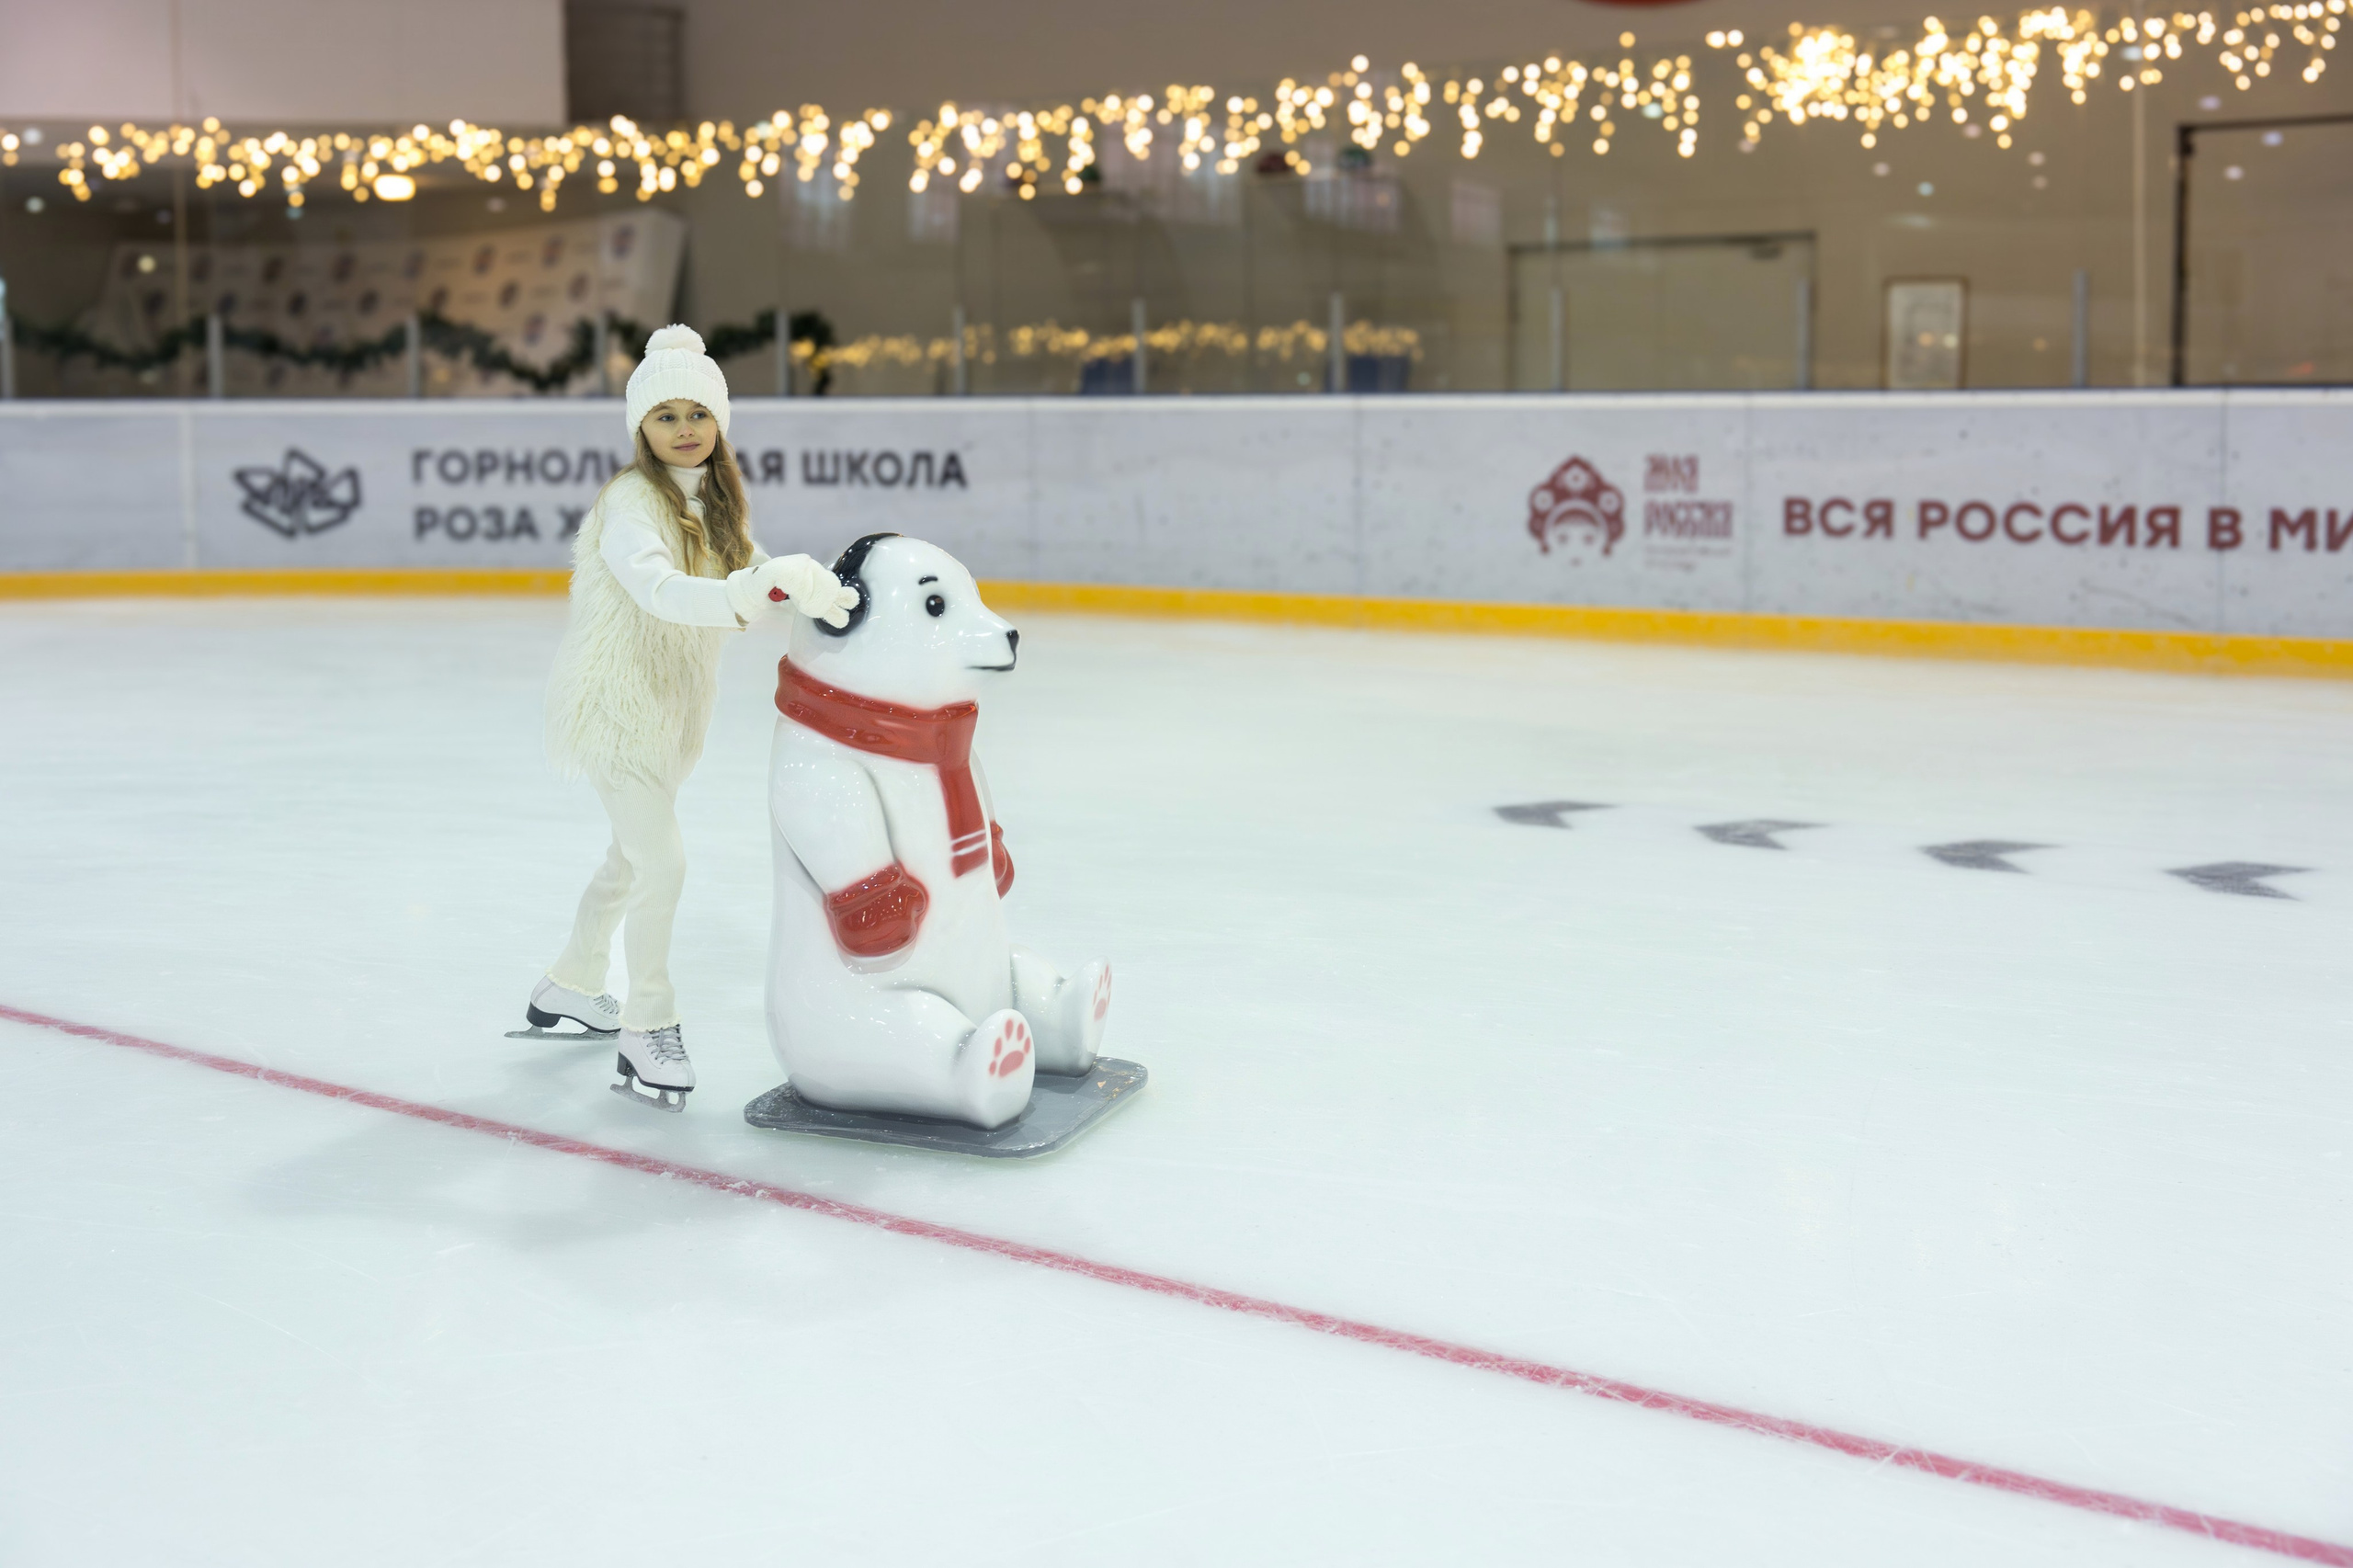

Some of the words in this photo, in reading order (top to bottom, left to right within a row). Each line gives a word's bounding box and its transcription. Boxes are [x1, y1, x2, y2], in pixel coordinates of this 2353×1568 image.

[801, 450, 969, 489] ШКОЛА
[414, 506, 541, 543] РОЗА
[1783, 497, 1895, 540] ВСЯ
[1918, 500, 2182, 549] РОССИЯ
[2207, 506, 2244, 551] В
